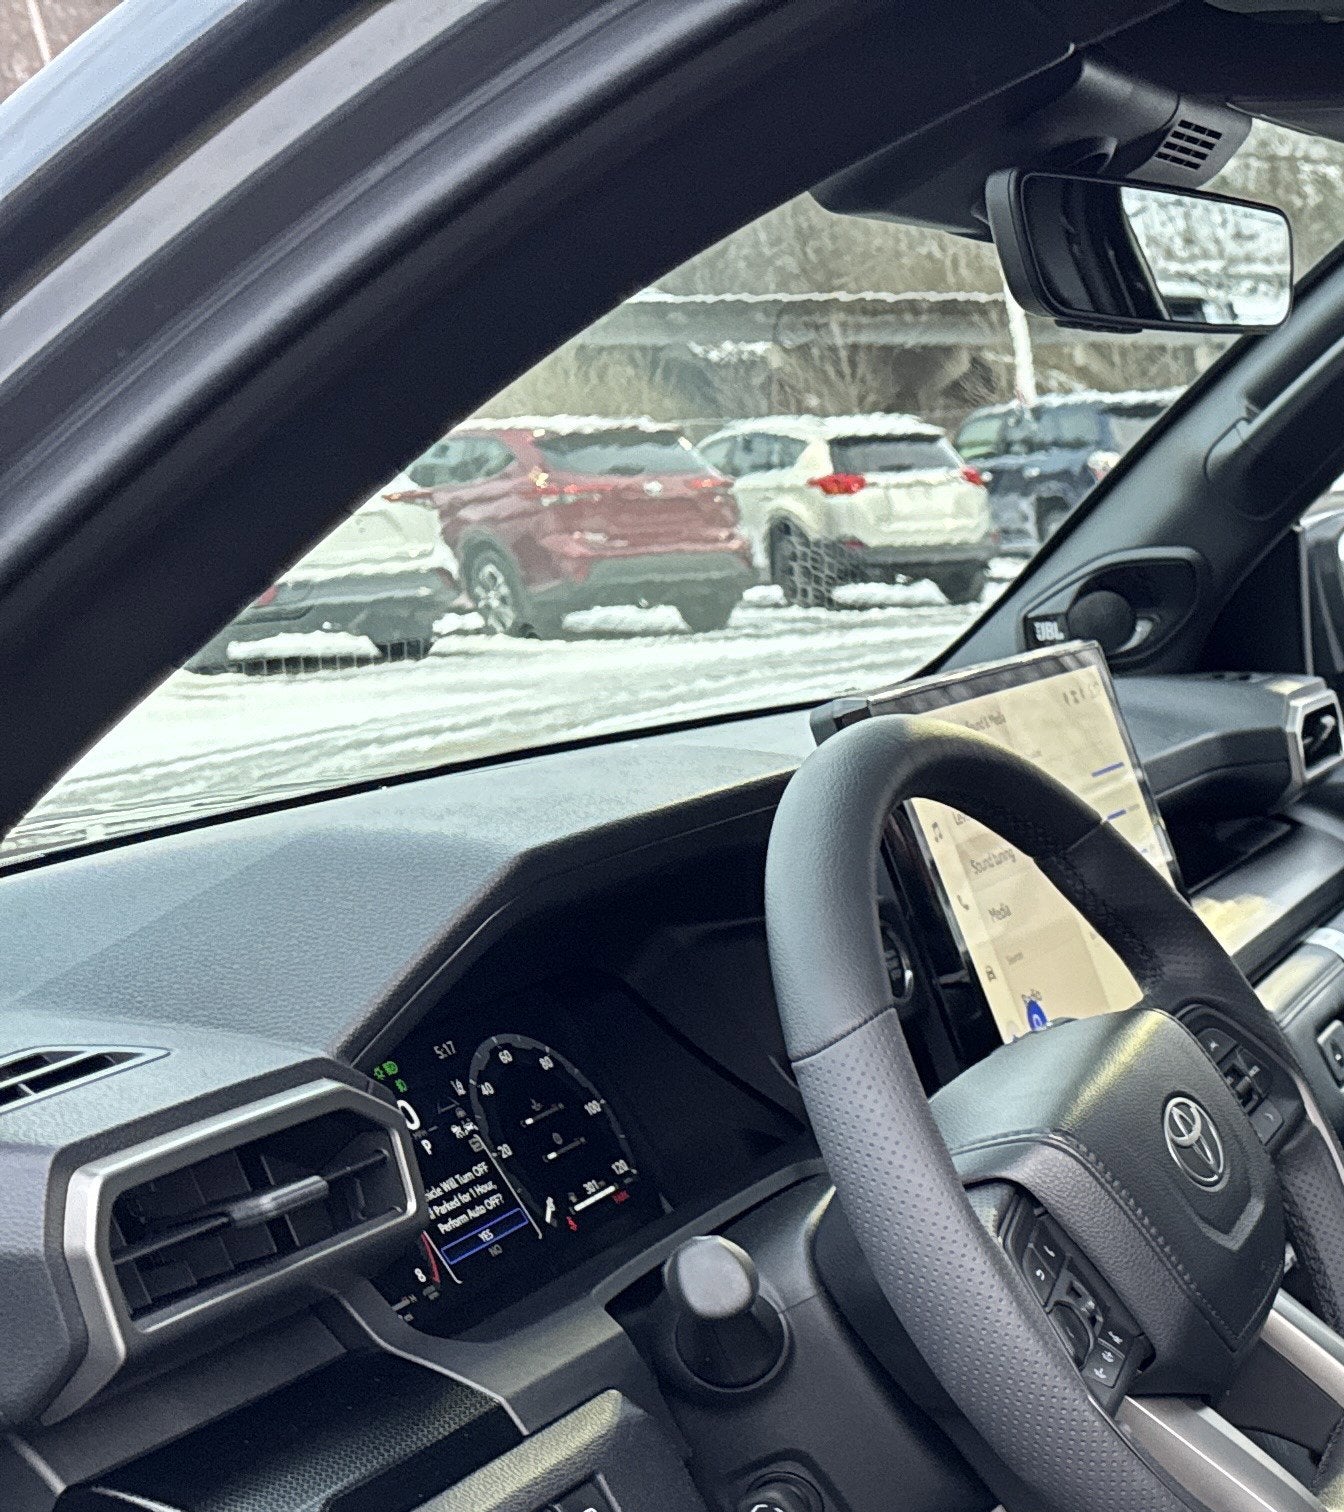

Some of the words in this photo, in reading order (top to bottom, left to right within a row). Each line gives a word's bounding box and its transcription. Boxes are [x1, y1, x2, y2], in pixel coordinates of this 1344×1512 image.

[472, 1161, 489, 1177] OFF
[432, 1195, 461, 1216] Parked
[437, 1214, 470, 1234] Perform
[467, 1204, 487, 1220] Auto
[484, 1193, 504, 1210] OFF?
[478, 1228, 494, 1242] YES
